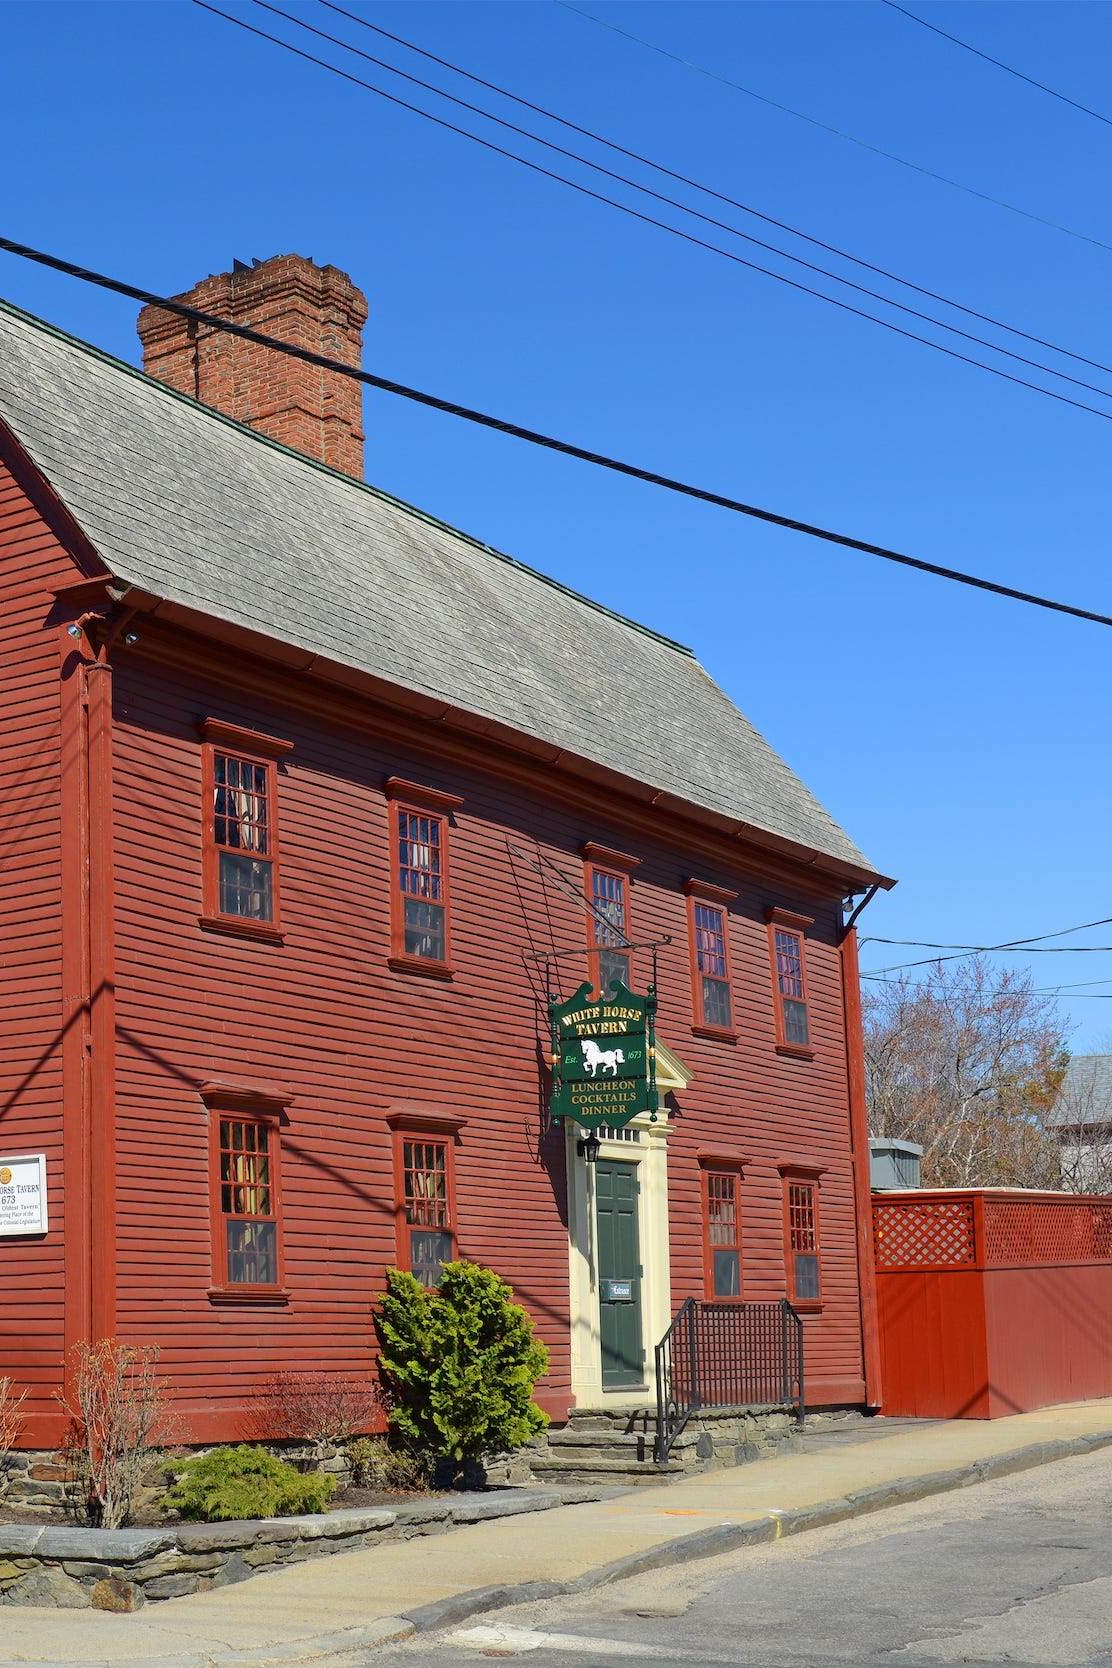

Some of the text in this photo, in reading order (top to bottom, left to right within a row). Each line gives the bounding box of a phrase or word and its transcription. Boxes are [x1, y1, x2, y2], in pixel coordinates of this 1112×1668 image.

[562, 1006, 642, 1026] WHITE HORSE
[576, 1021, 627, 1035] TAVERN
[565, 1051, 642, 1063] Est. 1673
[571, 1081, 636, 1093] LUNCHEON
[571, 1092, 636, 1104] COCKTAILS
[581, 1105, 627, 1116] DINNER
[17, 1184, 40, 1194] TAVERN
